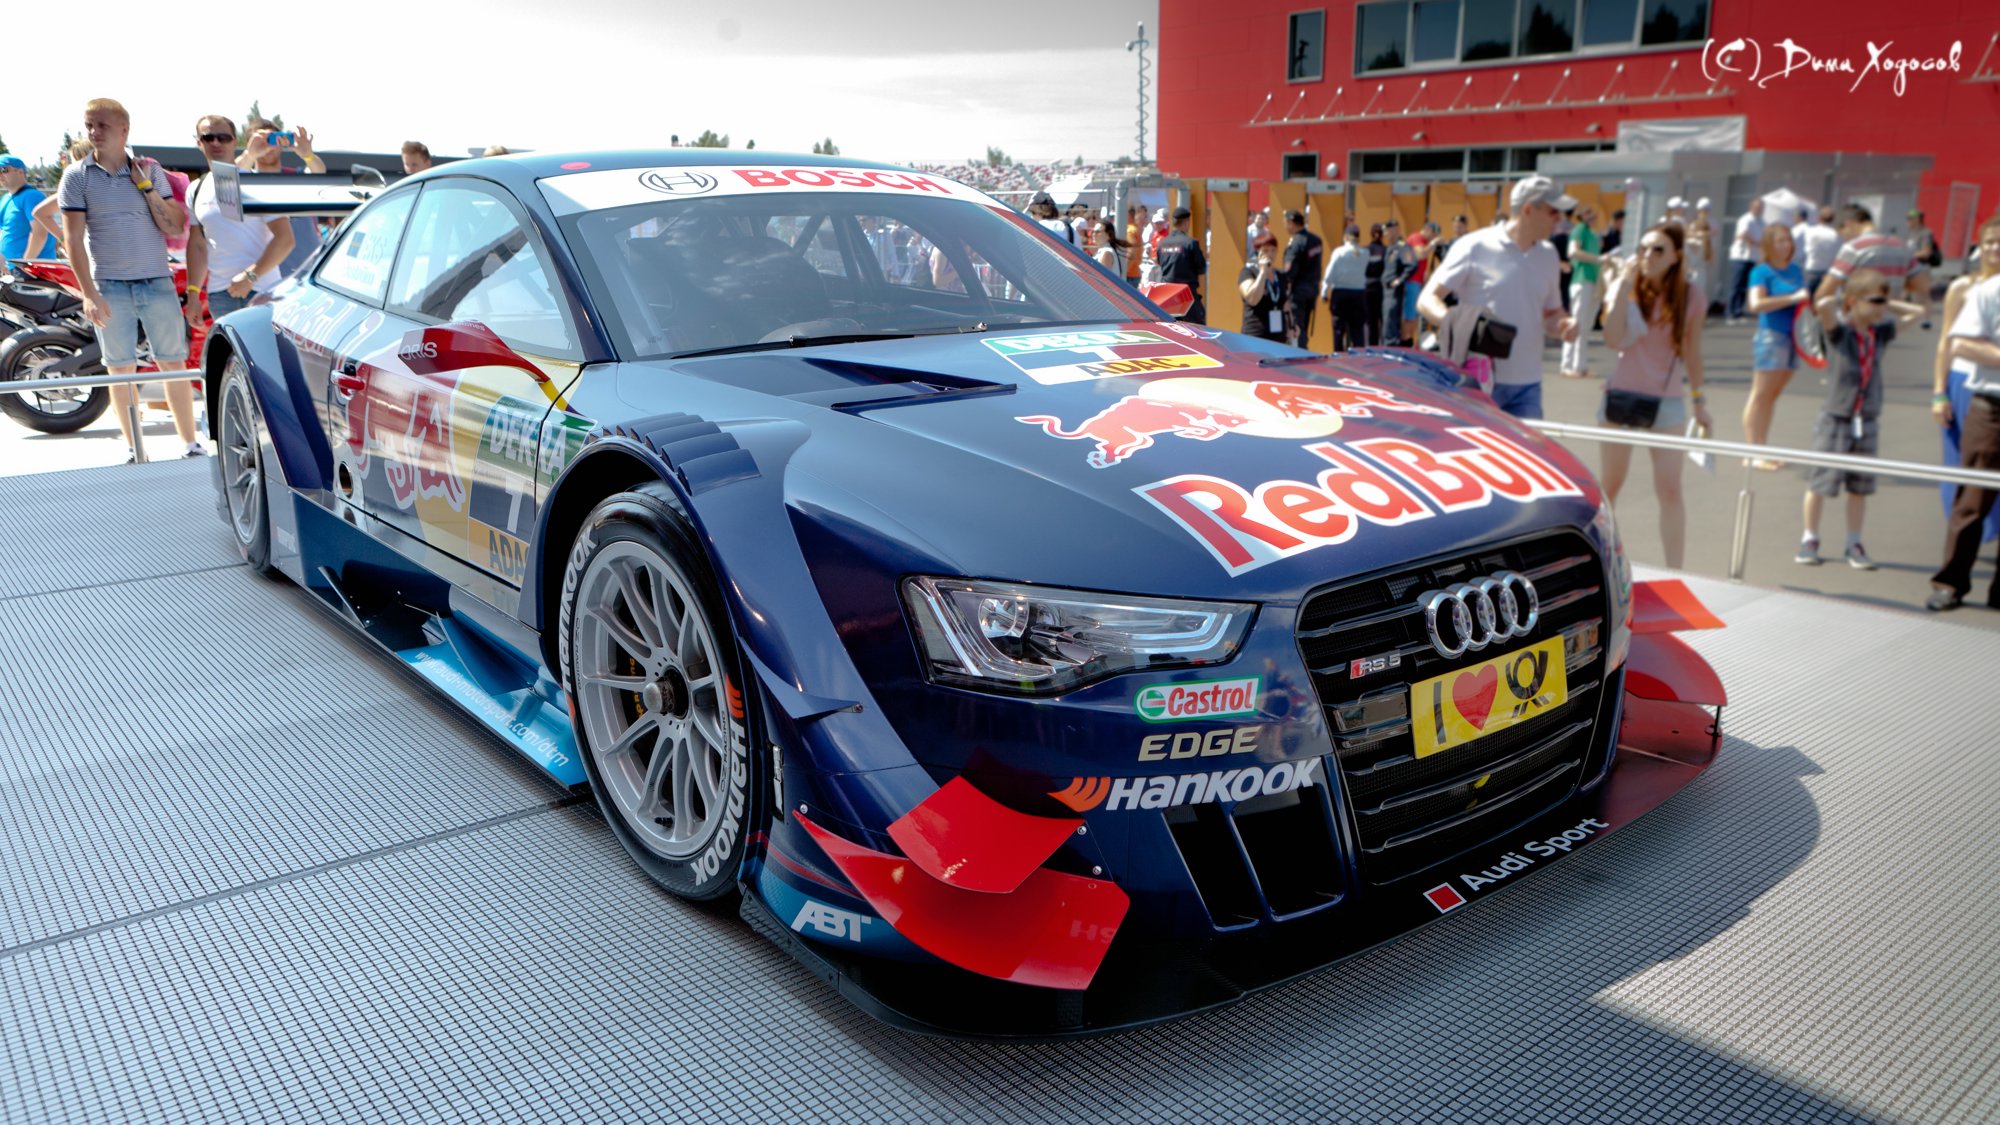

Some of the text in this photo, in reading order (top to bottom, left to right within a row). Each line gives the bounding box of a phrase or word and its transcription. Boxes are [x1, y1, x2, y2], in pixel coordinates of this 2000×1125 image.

[731, 169, 953, 195] BOSCH
[400, 341, 438, 361] ORIS
[1002, 332, 1164, 351] DEKRA
[1076, 357, 1191, 377] ADAC
[489, 407, 567, 475] DEKRA
[489, 529, 529, 582] ADA
[1168, 678, 1254, 717] Castrol
[1138, 725, 1264, 762] EDGE
[1459, 817, 1610, 892] Audi Sport
[791, 900, 872, 943] ABT
